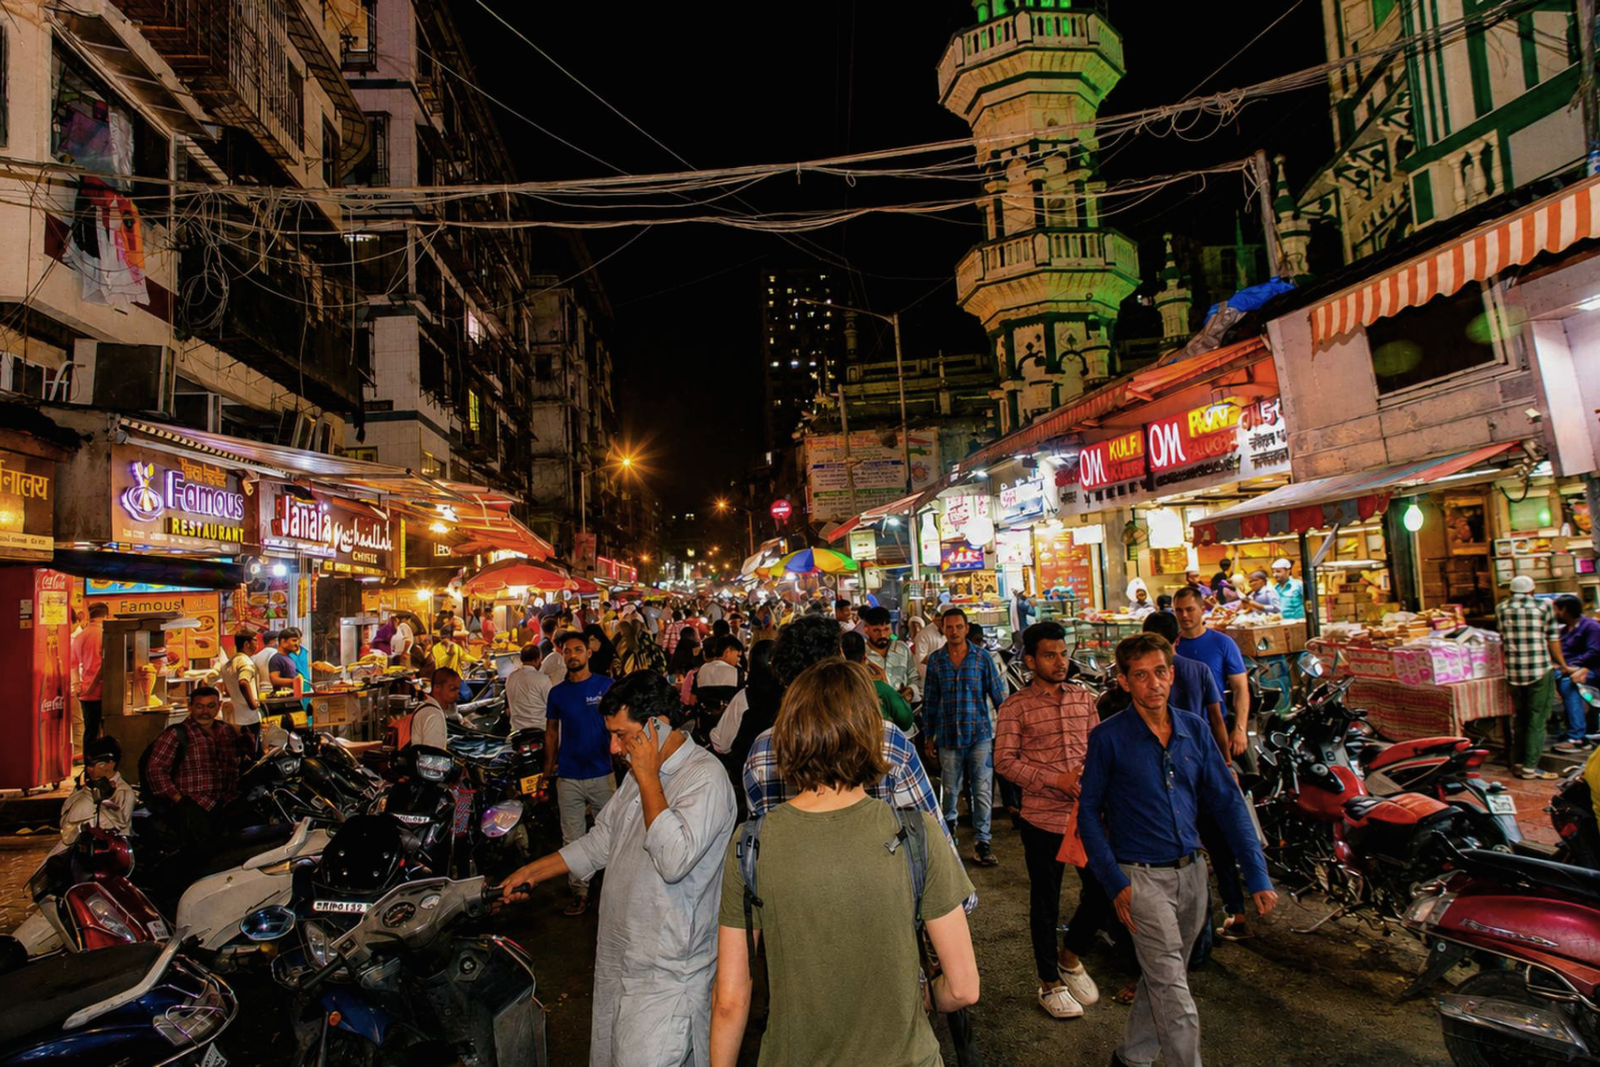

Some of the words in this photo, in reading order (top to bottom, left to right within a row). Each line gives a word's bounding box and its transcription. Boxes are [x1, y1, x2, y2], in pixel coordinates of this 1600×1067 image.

[1108, 434, 1142, 461] KULFI
[1150, 422, 1186, 467] OM
[1080, 448, 1107, 486] OM
[164, 470, 244, 520] Famous
[171, 517, 244, 543] RESTAURANT
